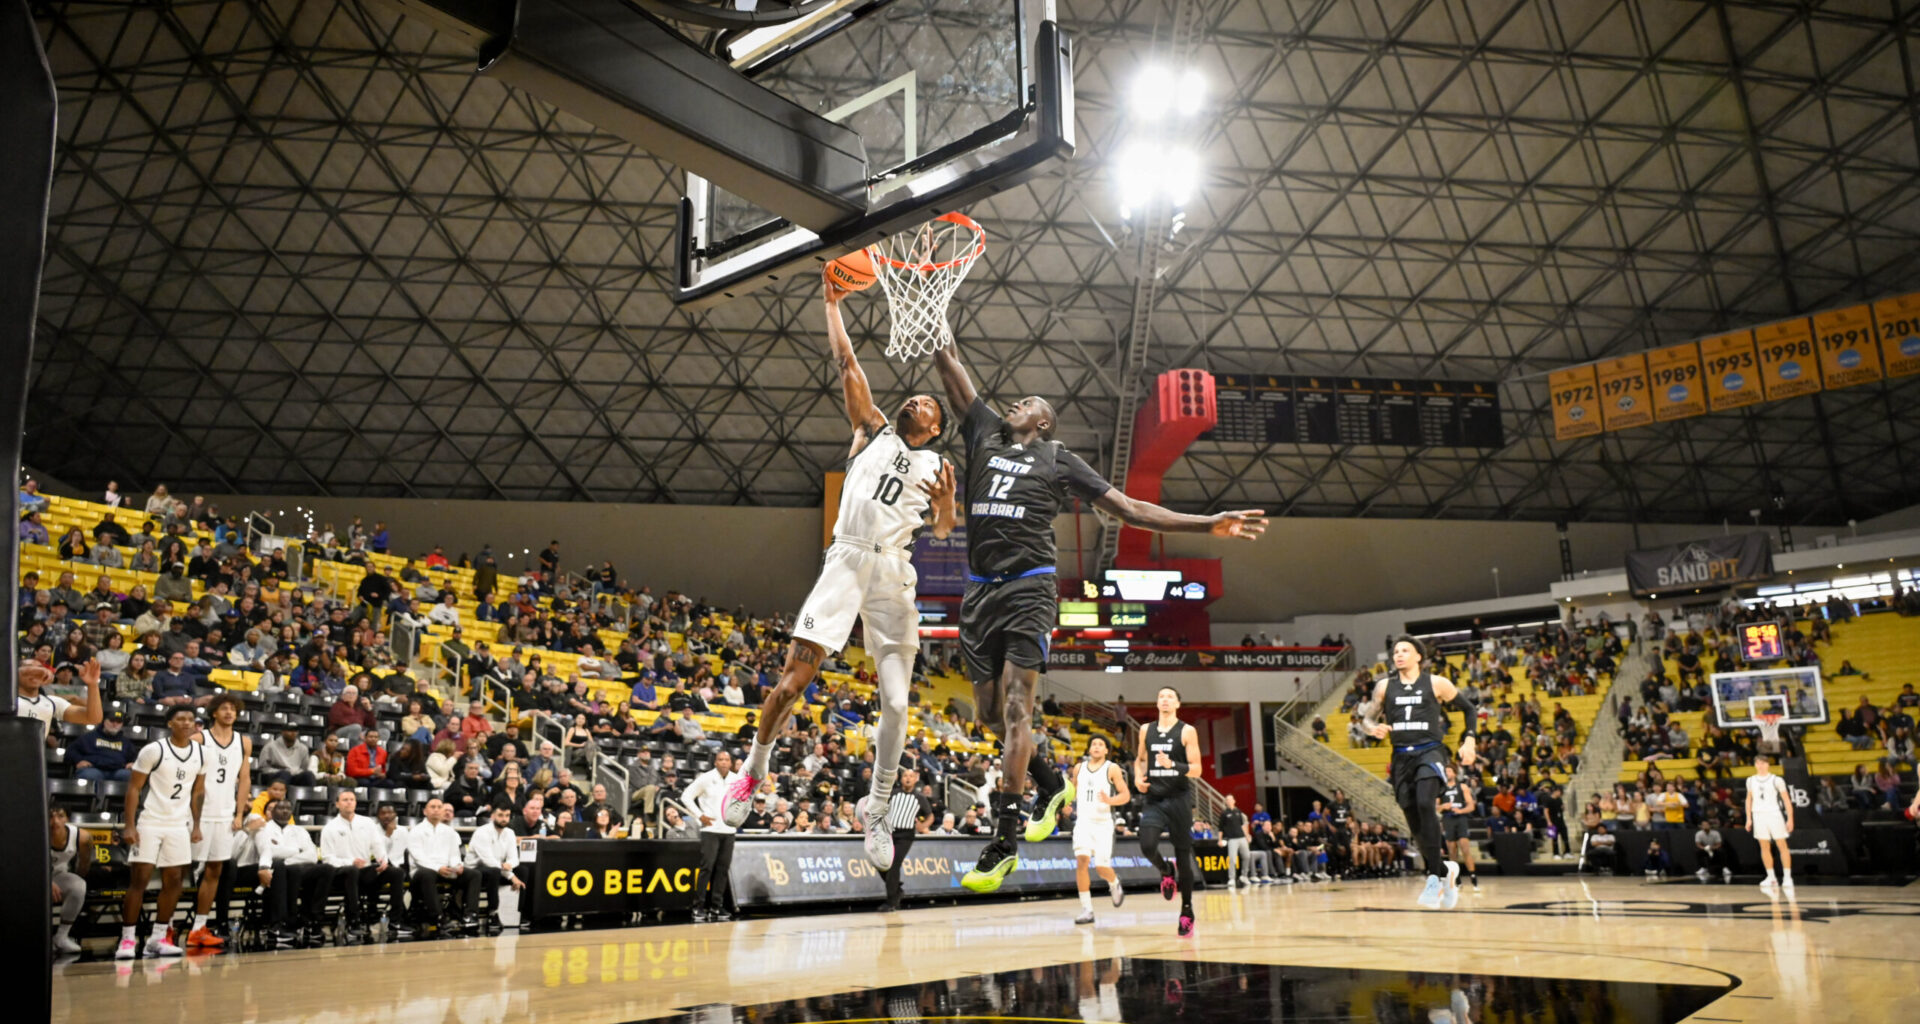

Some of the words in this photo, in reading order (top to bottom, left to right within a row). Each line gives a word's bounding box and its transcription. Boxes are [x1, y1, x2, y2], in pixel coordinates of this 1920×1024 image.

[833, 265, 869, 287] Wilson
[1821, 328, 1870, 352] 1991
[1762, 340, 1811, 364] 1998
[1707, 352, 1753, 376] 1993
[1602, 375, 1645, 397] 1973
[1652, 364, 1697, 387] 1989
[1554, 385, 1594, 406] 1972
[892, 450, 911, 474] LB
[987, 455, 1032, 475] SANTA
[872, 473, 904, 506] 10
[987, 473, 1016, 500] 12
[971, 502, 1026, 519] BARBARA
[1657, 558, 1739, 586] SANDPIT
[1124, 653, 1143, 665] Go
[1145, 652, 1187, 665] Beach!
[1224, 654, 1283, 665] IN-N-OUT
[1747, 637, 1778, 658] 27
[216, 768, 226, 784] 3
[170, 783, 183, 800] 2
[1086, 789, 1094, 802] 11
[1788, 784, 1811, 808] LB
[94, 844, 111, 864] LB
[797, 856, 843, 869] BEACH
[762, 852, 790, 886] LB
[801, 870, 845, 883] SHOPS
[847, 858, 877, 878] GIV
[902, 856, 951, 877] BACK!
[546, 869, 594, 897] GO
